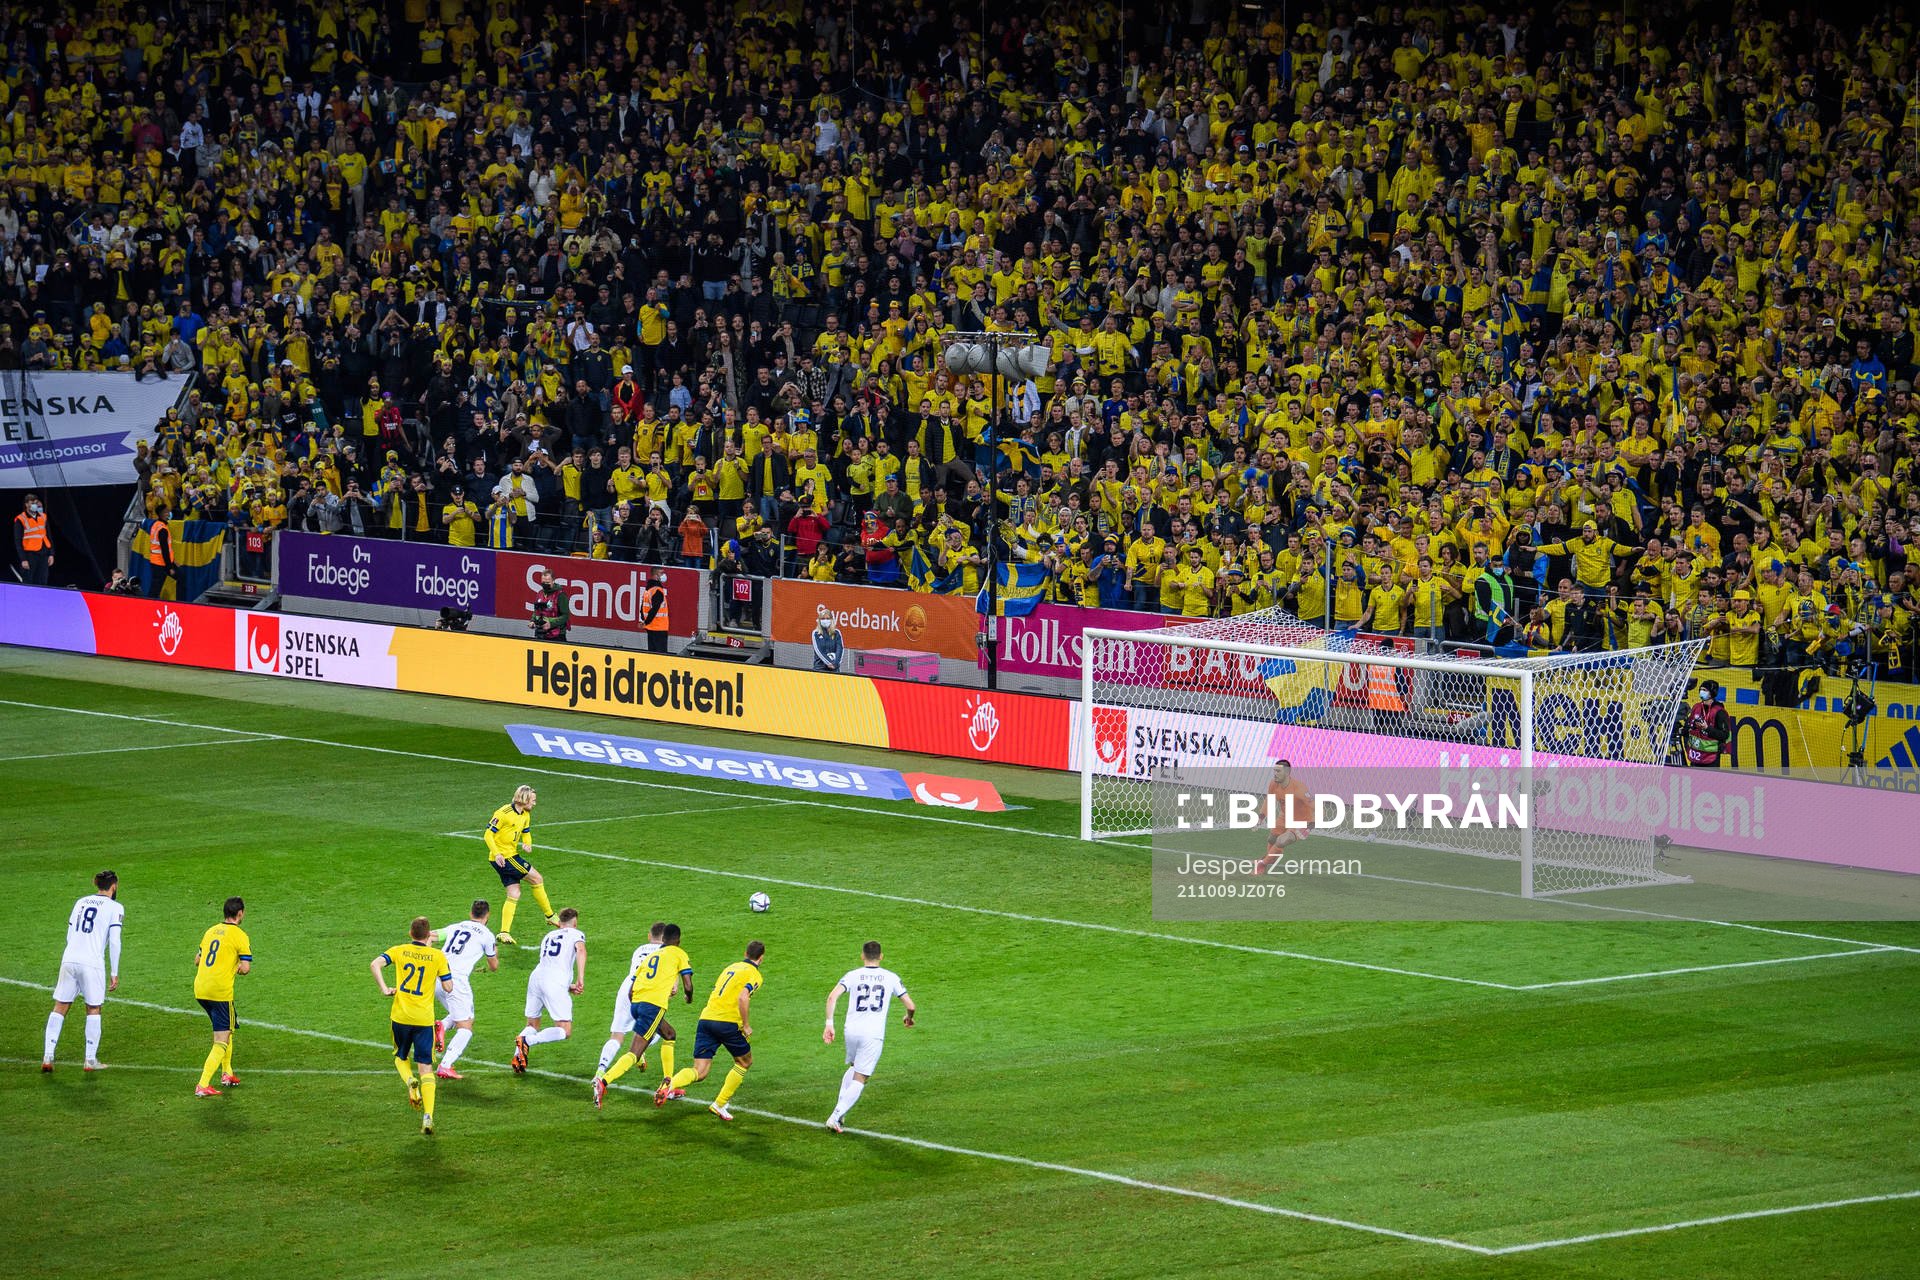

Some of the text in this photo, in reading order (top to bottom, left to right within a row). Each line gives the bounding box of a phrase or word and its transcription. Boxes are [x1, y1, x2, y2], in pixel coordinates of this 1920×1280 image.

[248, 537, 262, 548] 103
[308, 554, 370, 595] Fabege
[416, 564, 479, 606] Fabege
[735, 583, 749, 594] 102
[286, 630, 360, 657] SVENSKA
[286, 655, 323, 678] SPEL
[527, 649, 744, 717] Heja idrotten!
[1135, 726, 1231, 758] SVENSKA
[532, 733, 868, 790] Heja Sverige!
[1135, 753, 1184, 781] SPEL
[76, 905, 98, 933] 18
[206, 939, 220, 967] 8
[445, 929, 471, 954] 13
[543, 935, 563, 957] 15
[400, 963, 425, 996] 21
[646, 955, 660, 979] 9
[718, 971, 735, 996] 7
[856, 984, 885, 1012] 23
